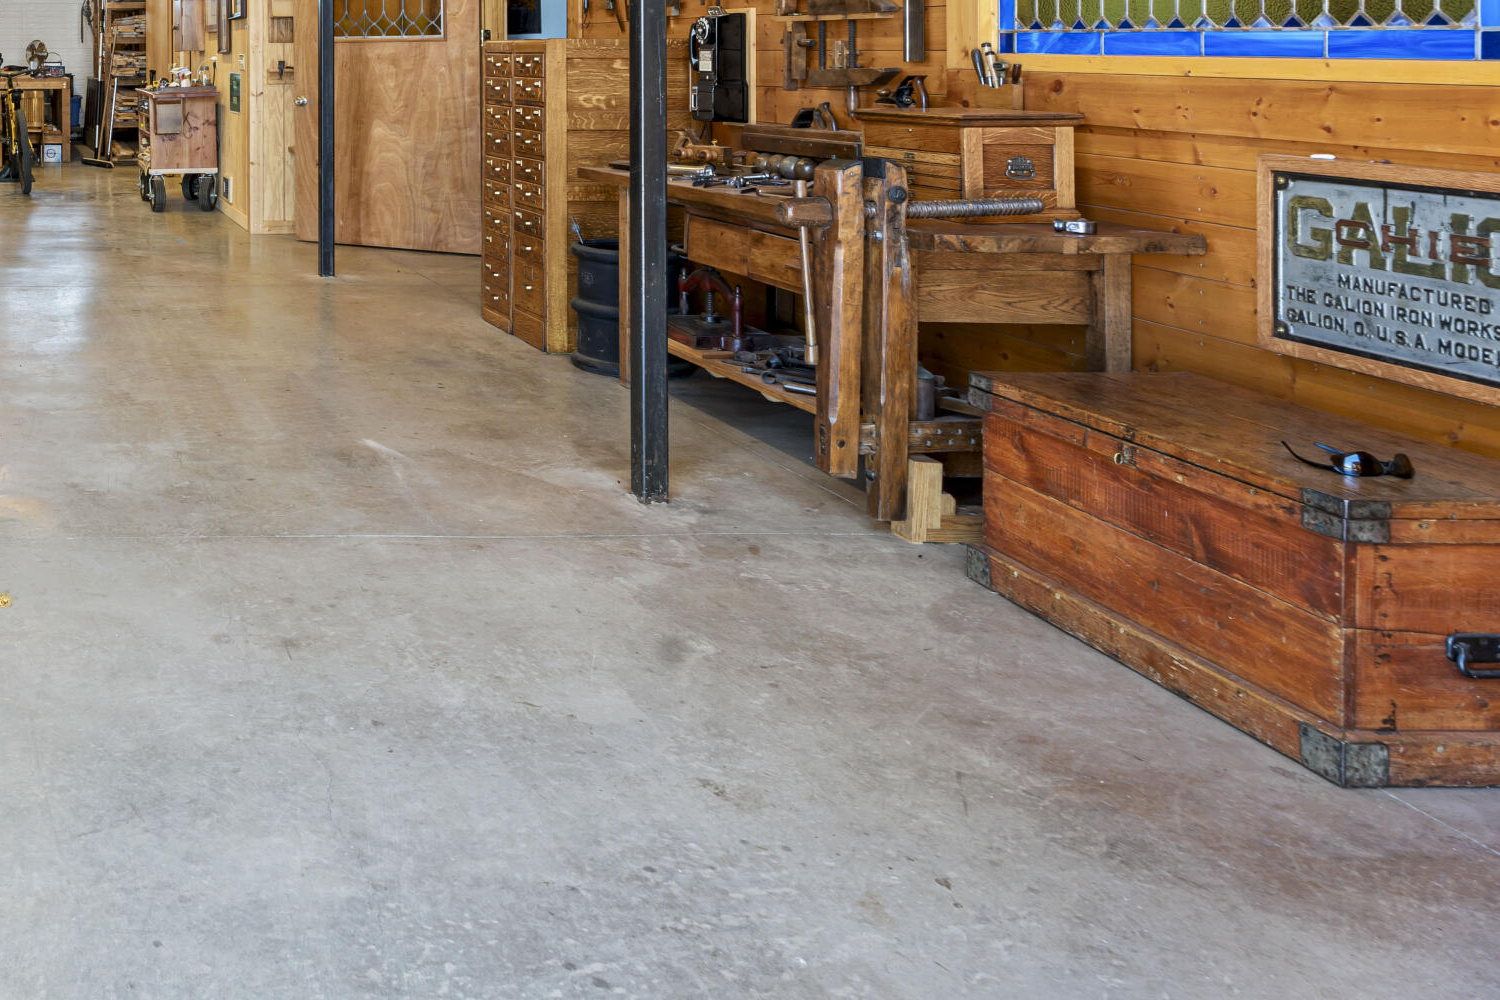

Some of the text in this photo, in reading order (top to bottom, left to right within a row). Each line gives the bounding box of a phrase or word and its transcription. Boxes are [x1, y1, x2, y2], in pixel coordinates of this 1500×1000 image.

[1286, 285, 1317, 305] THE
[1323, 292, 1386, 318] GALION
[1391, 305, 1434, 328] IRON
[1338, 273, 1491, 315] MANUFACTURED
[1286, 308, 1349, 336] GALION,
